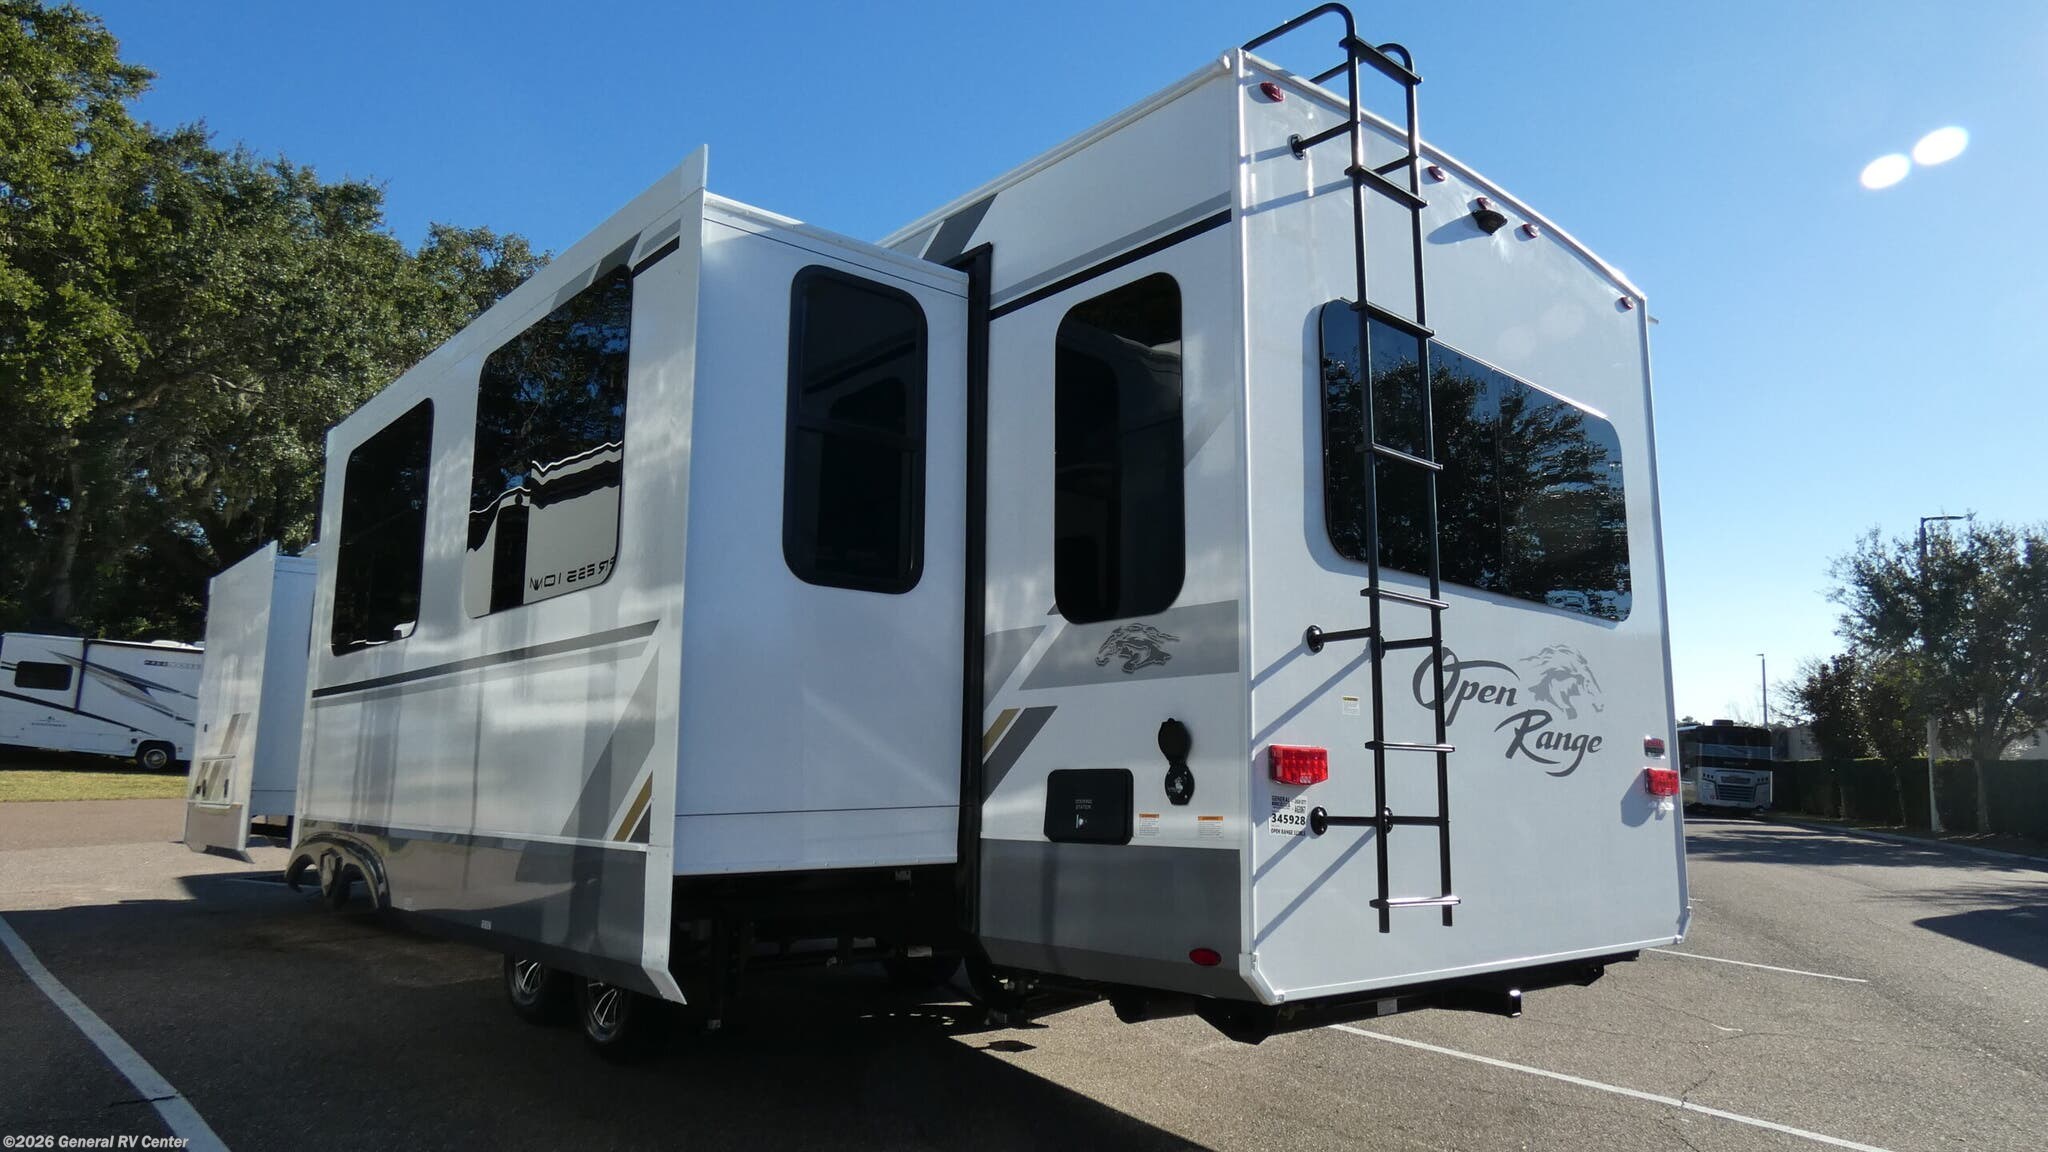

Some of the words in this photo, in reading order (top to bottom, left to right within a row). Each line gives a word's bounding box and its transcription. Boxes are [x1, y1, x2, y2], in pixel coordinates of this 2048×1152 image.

[1413, 646, 1520, 727] Open
[1494, 709, 1603, 777] Range
[1271, 813, 1306, 825] 345928
